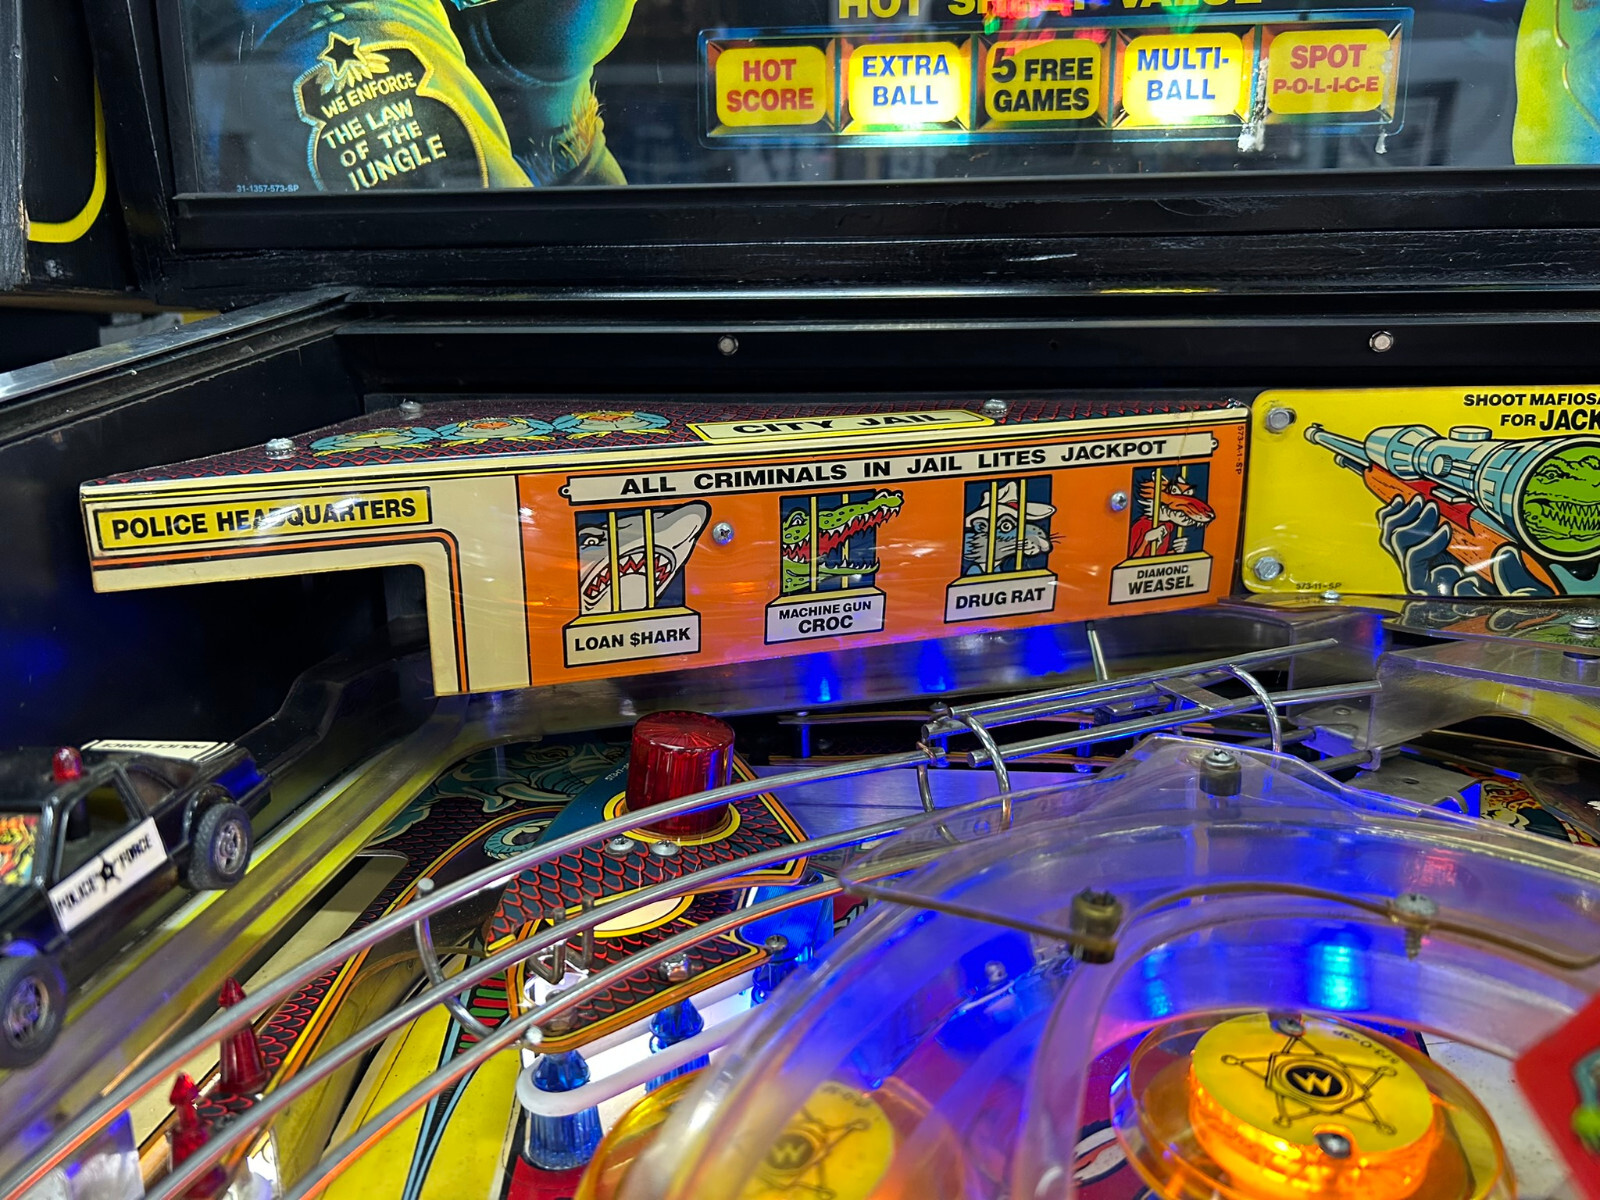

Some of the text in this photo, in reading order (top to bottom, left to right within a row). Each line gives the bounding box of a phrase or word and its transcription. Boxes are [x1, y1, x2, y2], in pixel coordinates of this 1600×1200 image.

[862, 54, 950, 77] EXTRA
[991, 48, 1093, 83] 5 FREE
[1137, 47, 1230, 71] MULTI-
[1290, 44, 1367, 70] SPOT
[743, 59, 796, 82] HOT
[320, 71, 418, 119] WE ENFORCE
[873, 85, 939, 106] BALL
[1147, 79, 1216, 101] BALL
[1273, 76, 1380, 94] P-O-L-I-C-E
[726, 88, 814, 112] SCORE
[993, 88, 1090, 113] GAMES
[322, 98, 414, 149] THE LAW
[340, 120, 423, 168] OF THE
[348, 134, 448, 191] JUNGLE
[236, 184, 300, 193] 31-1357-573-SP
[1463, 393, 1600, 406] SHOOT MAFIOS
[732, 413, 952, 435] CITY JAIL
[1500, 414, 1536, 426] FOR
[620, 440, 1167, 495] ALL CRIMINALS IN JAIL LITES JACKPOT
[112, 511, 208, 540] POLICE
[1136, 565, 1189, 580] DIAMOND
[1127, 577, 1194, 595] WEASEL
[955, 587, 1045, 609] DRUG RAT
[778, 600, 872, 620] MACHINE GUN
[798, 614, 853, 634] CROC
[574, 627, 691, 652] LOAN $HARK
[57, 835, 152, 916] POLICE FORCE
